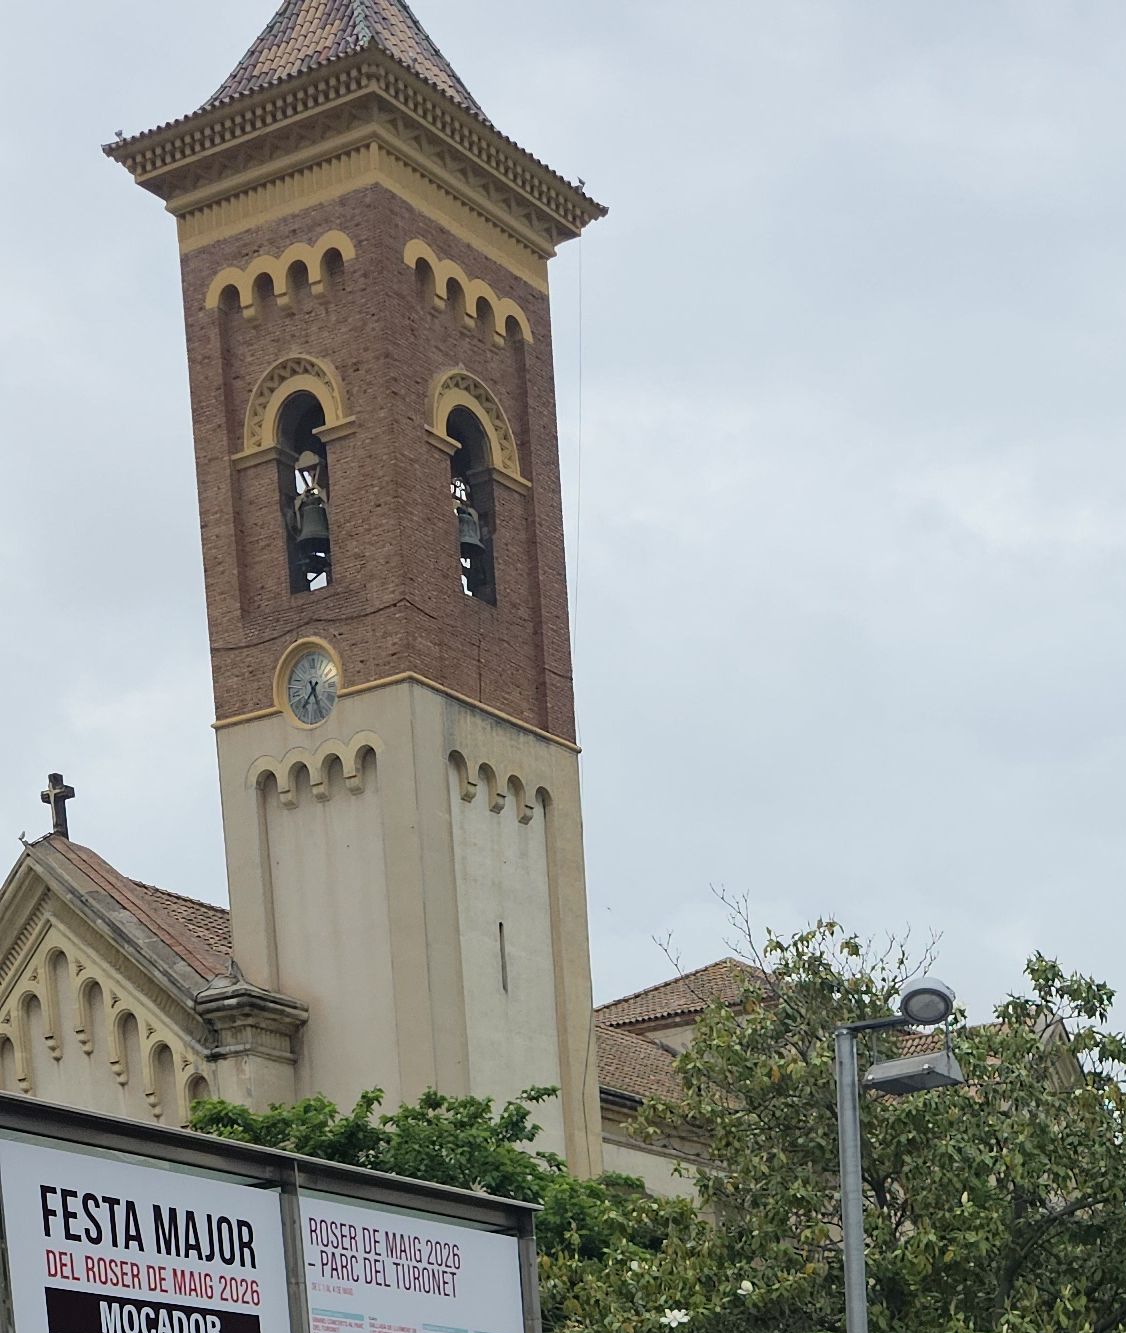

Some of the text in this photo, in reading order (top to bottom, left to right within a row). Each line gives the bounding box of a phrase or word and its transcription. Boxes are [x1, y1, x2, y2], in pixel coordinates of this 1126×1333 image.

[40, 1184, 257, 1269] FESTA MAJOR
[308, 1217, 461, 1270] ROSER DE MAIG 2026
[46, 1249, 261, 1306] DEL ROSER DE MAIG 2026
[320, 1250, 359, 1283] PARC
[363, 1257, 391, 1287] DEL
[393, 1262, 457, 1298] TURONET
